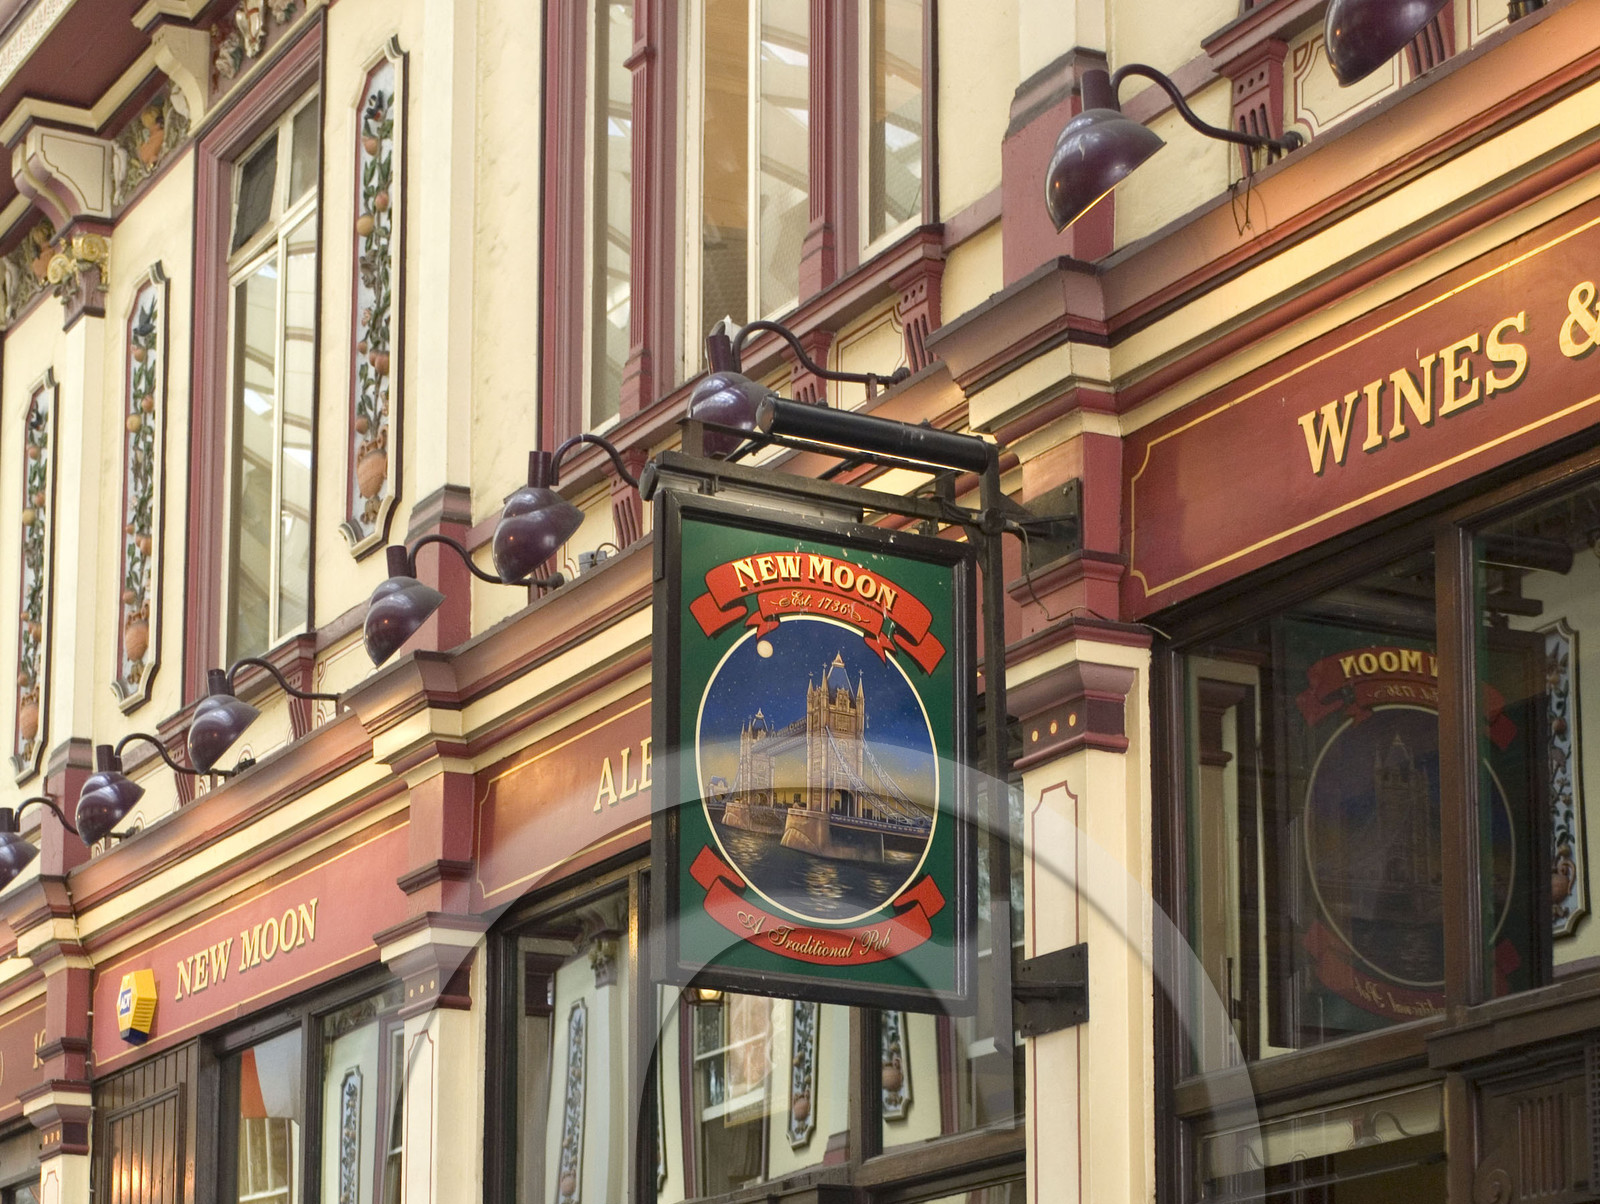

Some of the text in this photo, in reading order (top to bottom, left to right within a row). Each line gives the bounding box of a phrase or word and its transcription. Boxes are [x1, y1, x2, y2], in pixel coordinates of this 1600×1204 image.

[1298, 281, 1600, 475] WINES &
[732, 554, 898, 612] NEW MOON
[790, 590, 850, 616] Est. 1736
[175, 897, 318, 1001] NEW MOON
[736, 911, 892, 958] A Traditional Pub
